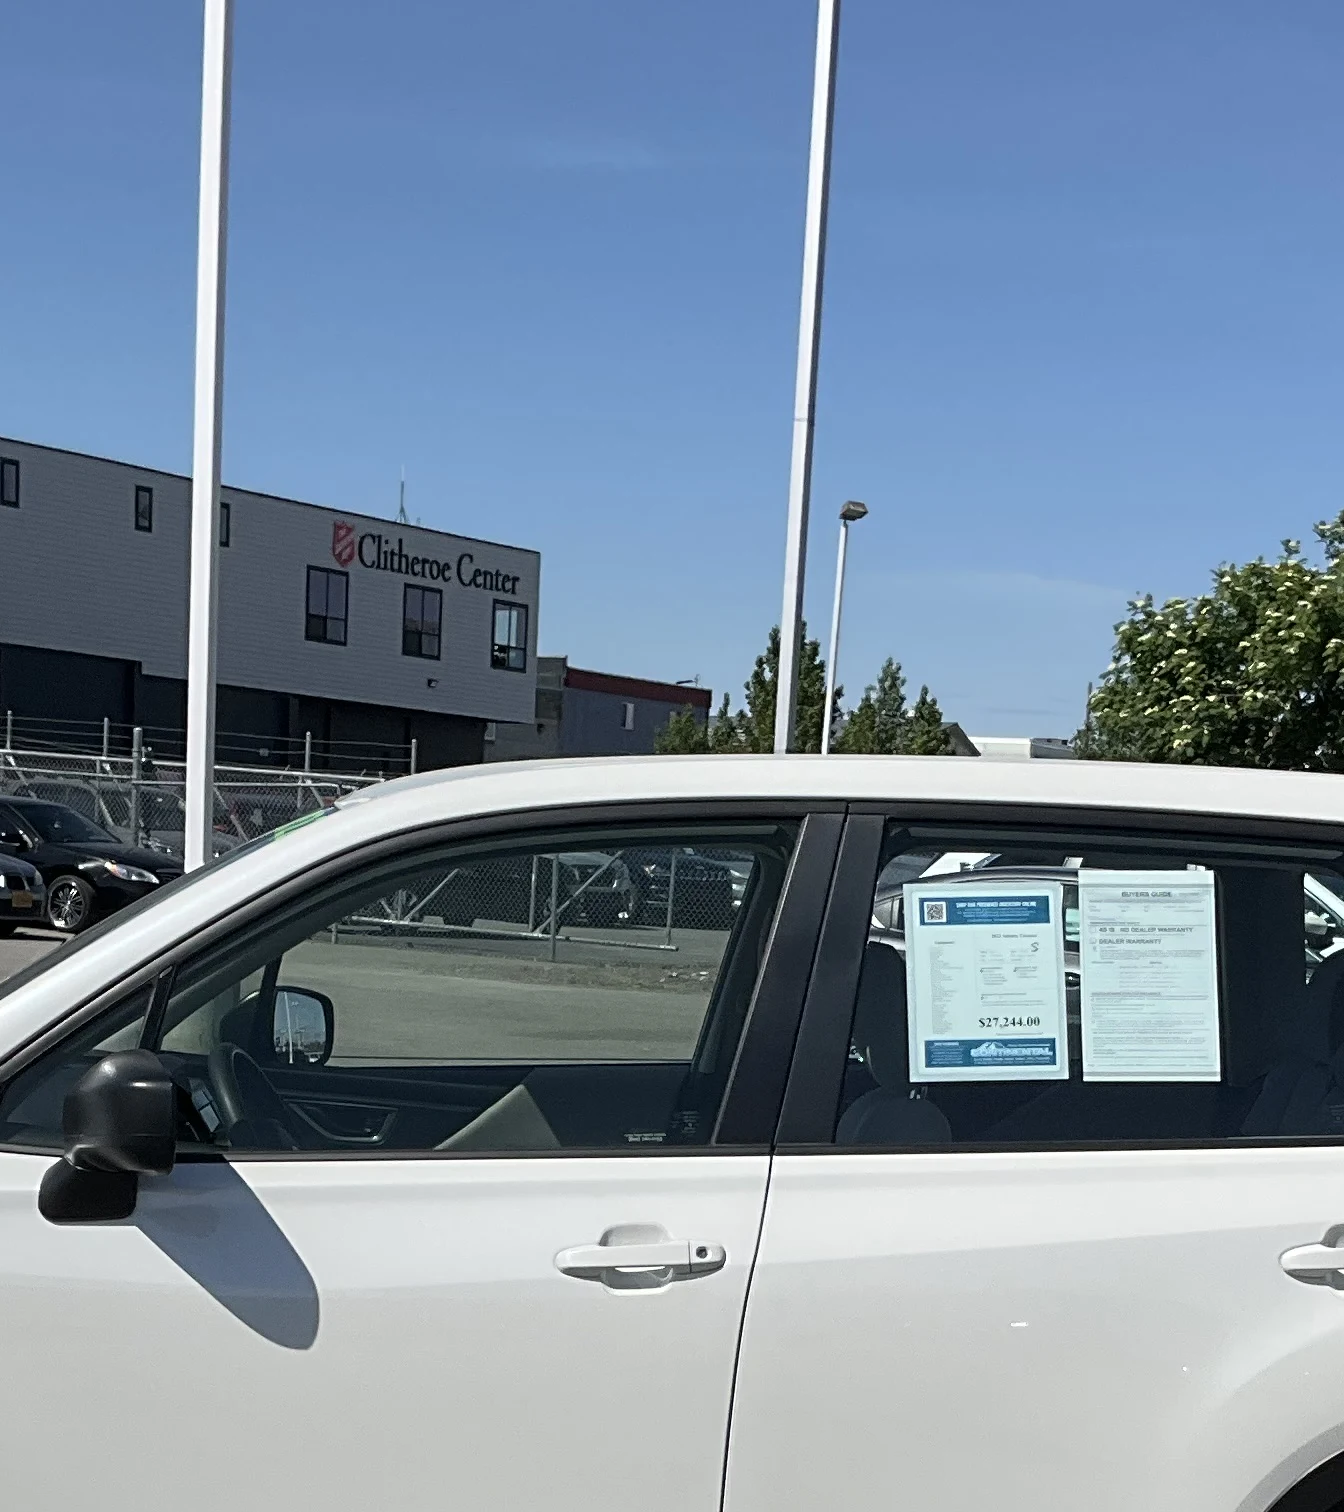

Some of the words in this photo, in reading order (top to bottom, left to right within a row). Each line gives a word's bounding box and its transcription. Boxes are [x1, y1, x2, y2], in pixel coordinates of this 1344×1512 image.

[358, 534, 452, 582] Clitheroe
[456, 553, 521, 595] Center
[978, 1016, 1041, 1029] $27,244.00
